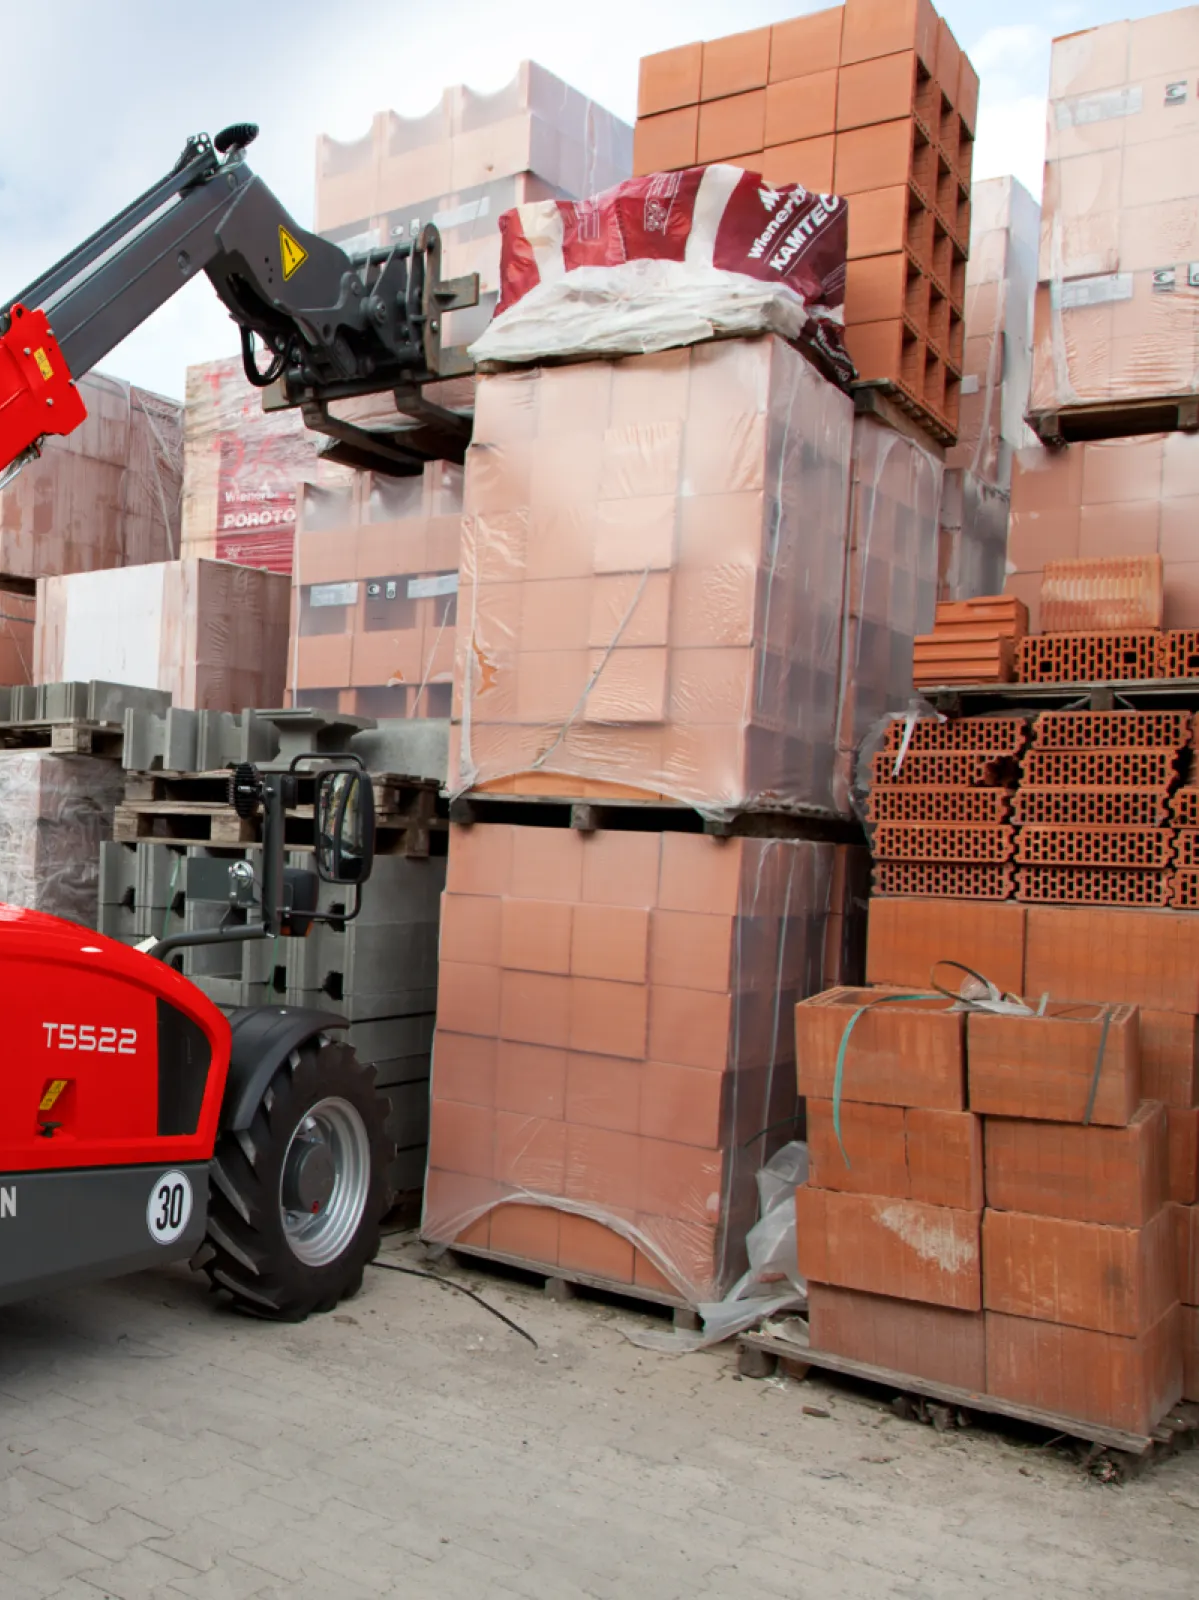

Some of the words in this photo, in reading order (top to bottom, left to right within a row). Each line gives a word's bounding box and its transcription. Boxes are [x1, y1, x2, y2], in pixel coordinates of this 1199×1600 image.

[223, 507, 297, 529] POROTO
[42, 1022, 137, 1054] T5522
[156, 1183, 184, 1231] 30
